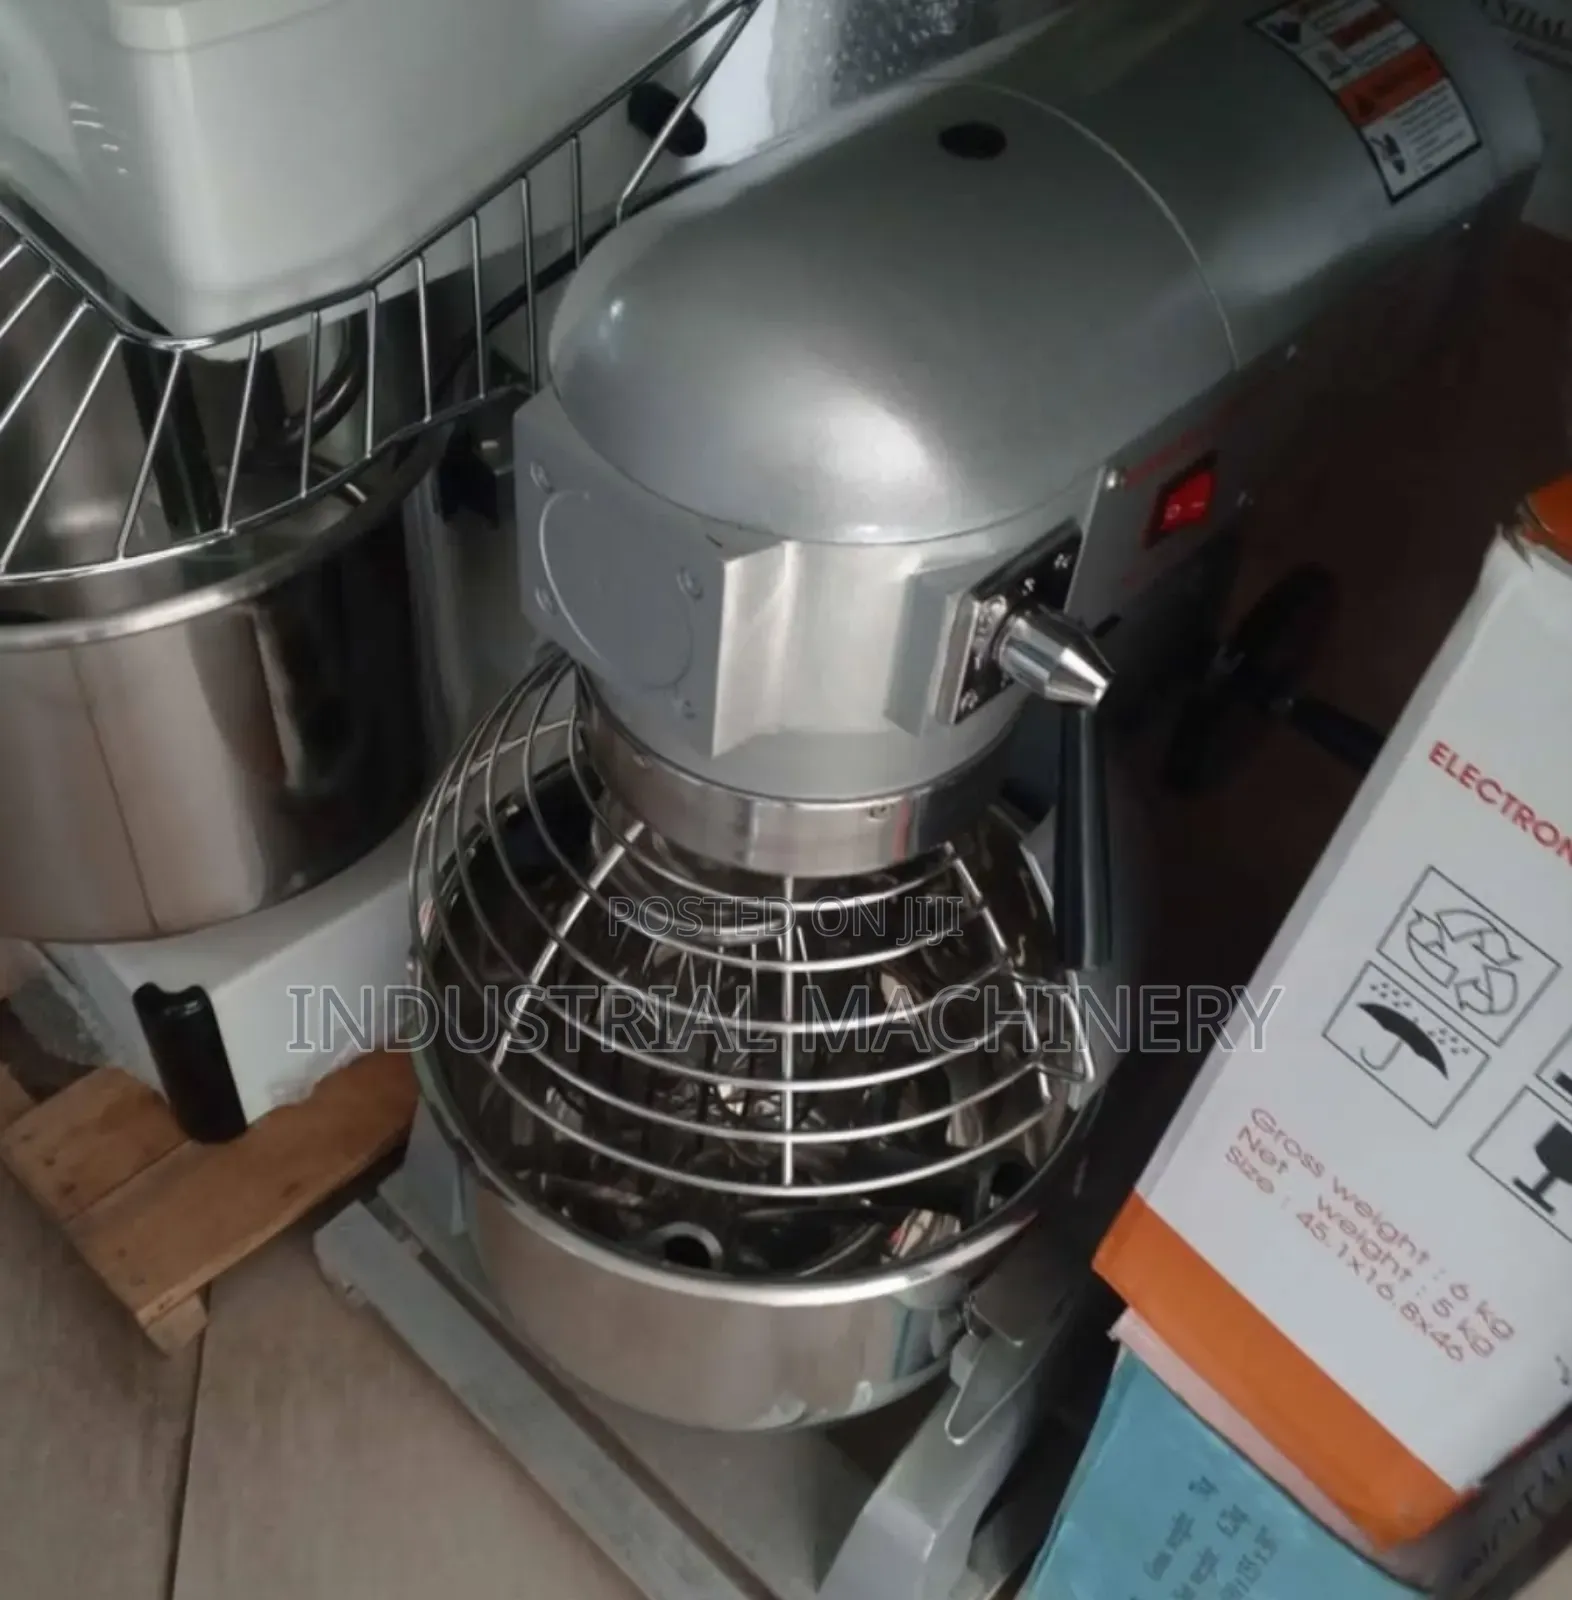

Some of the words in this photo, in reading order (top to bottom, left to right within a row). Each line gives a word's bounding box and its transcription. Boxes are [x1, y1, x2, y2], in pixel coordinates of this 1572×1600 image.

[1225, 1145, 1275, 1195] Size
[1237, 1125, 1288, 1175] Net
[1318, 1195, 1413, 1284] weight
[1251, 1107, 1325, 1178] Gross
[1333, 1176, 1430, 1265] weight
